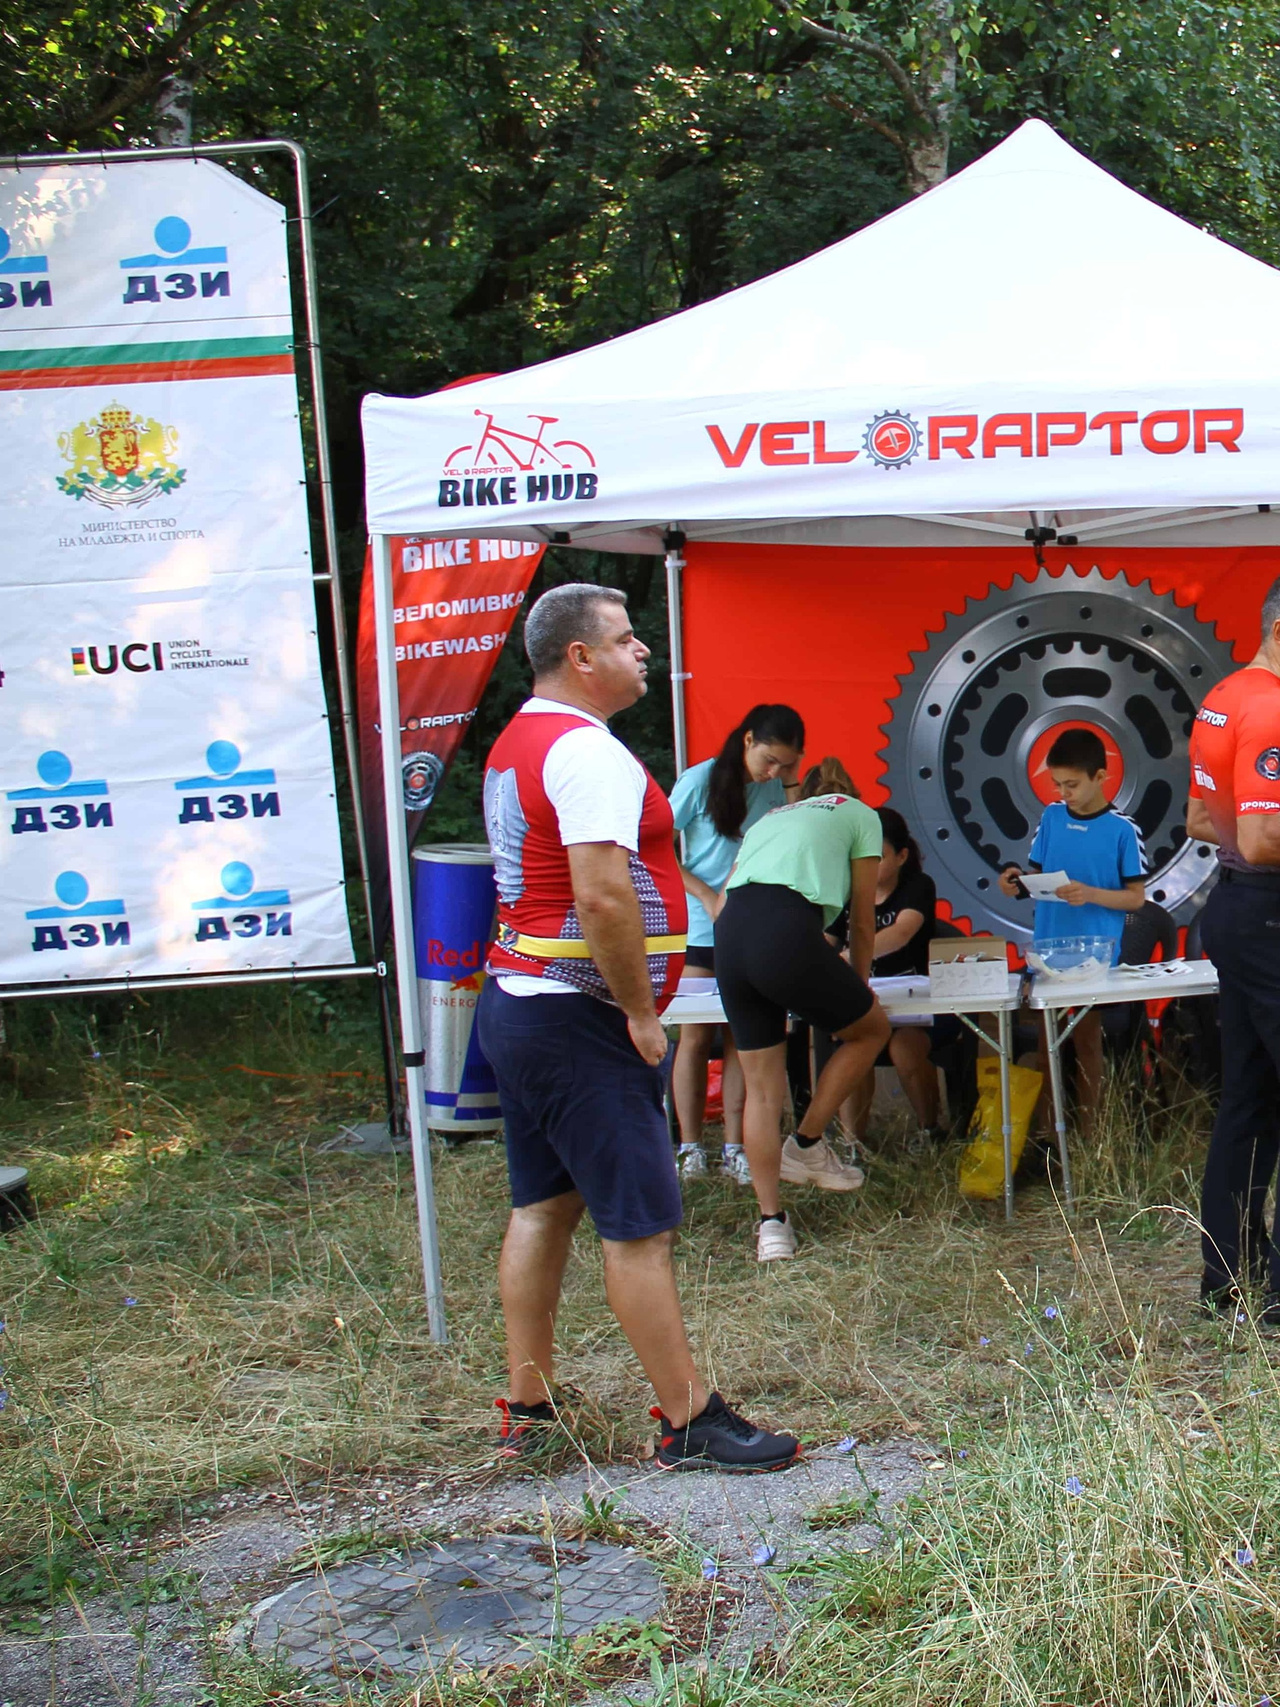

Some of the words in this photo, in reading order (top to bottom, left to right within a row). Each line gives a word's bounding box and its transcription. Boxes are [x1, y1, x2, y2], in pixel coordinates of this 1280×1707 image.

[0, 281, 53, 309] ЗИ
[123, 270, 231, 304] ДЗИ
[438, 476, 518, 507] BIKE
[526, 473, 598, 502] HUB
[58, 536, 76, 547] НА
[79, 533, 146, 546] МЛАДЕЖТА
[149, 532, 157, 541] И
[159, 530, 205, 541] СПОРТА
[82, 518, 177, 533] МИНИСТЕРСТВО
[402, 538, 472, 573] BIKE
[393, 590, 526, 624] ВЕЛОМИВКА
[87, 641, 164, 675] UCI
[168, 639, 200, 649] UNION
[169, 649, 212, 660] CYCLISTE
[394, 631, 507, 662] BIKEWASH
[170, 658, 250, 670] INTERNATIONALE
[12, 802, 114, 834] ДЗИ
[179, 792, 281, 824] ДЗИ
[32, 921, 131, 952] ДЗИ
[195, 912, 292, 942] ДЗИ
[428, 938, 480, 968] Red
[432, 996, 476, 1008] ENERG
